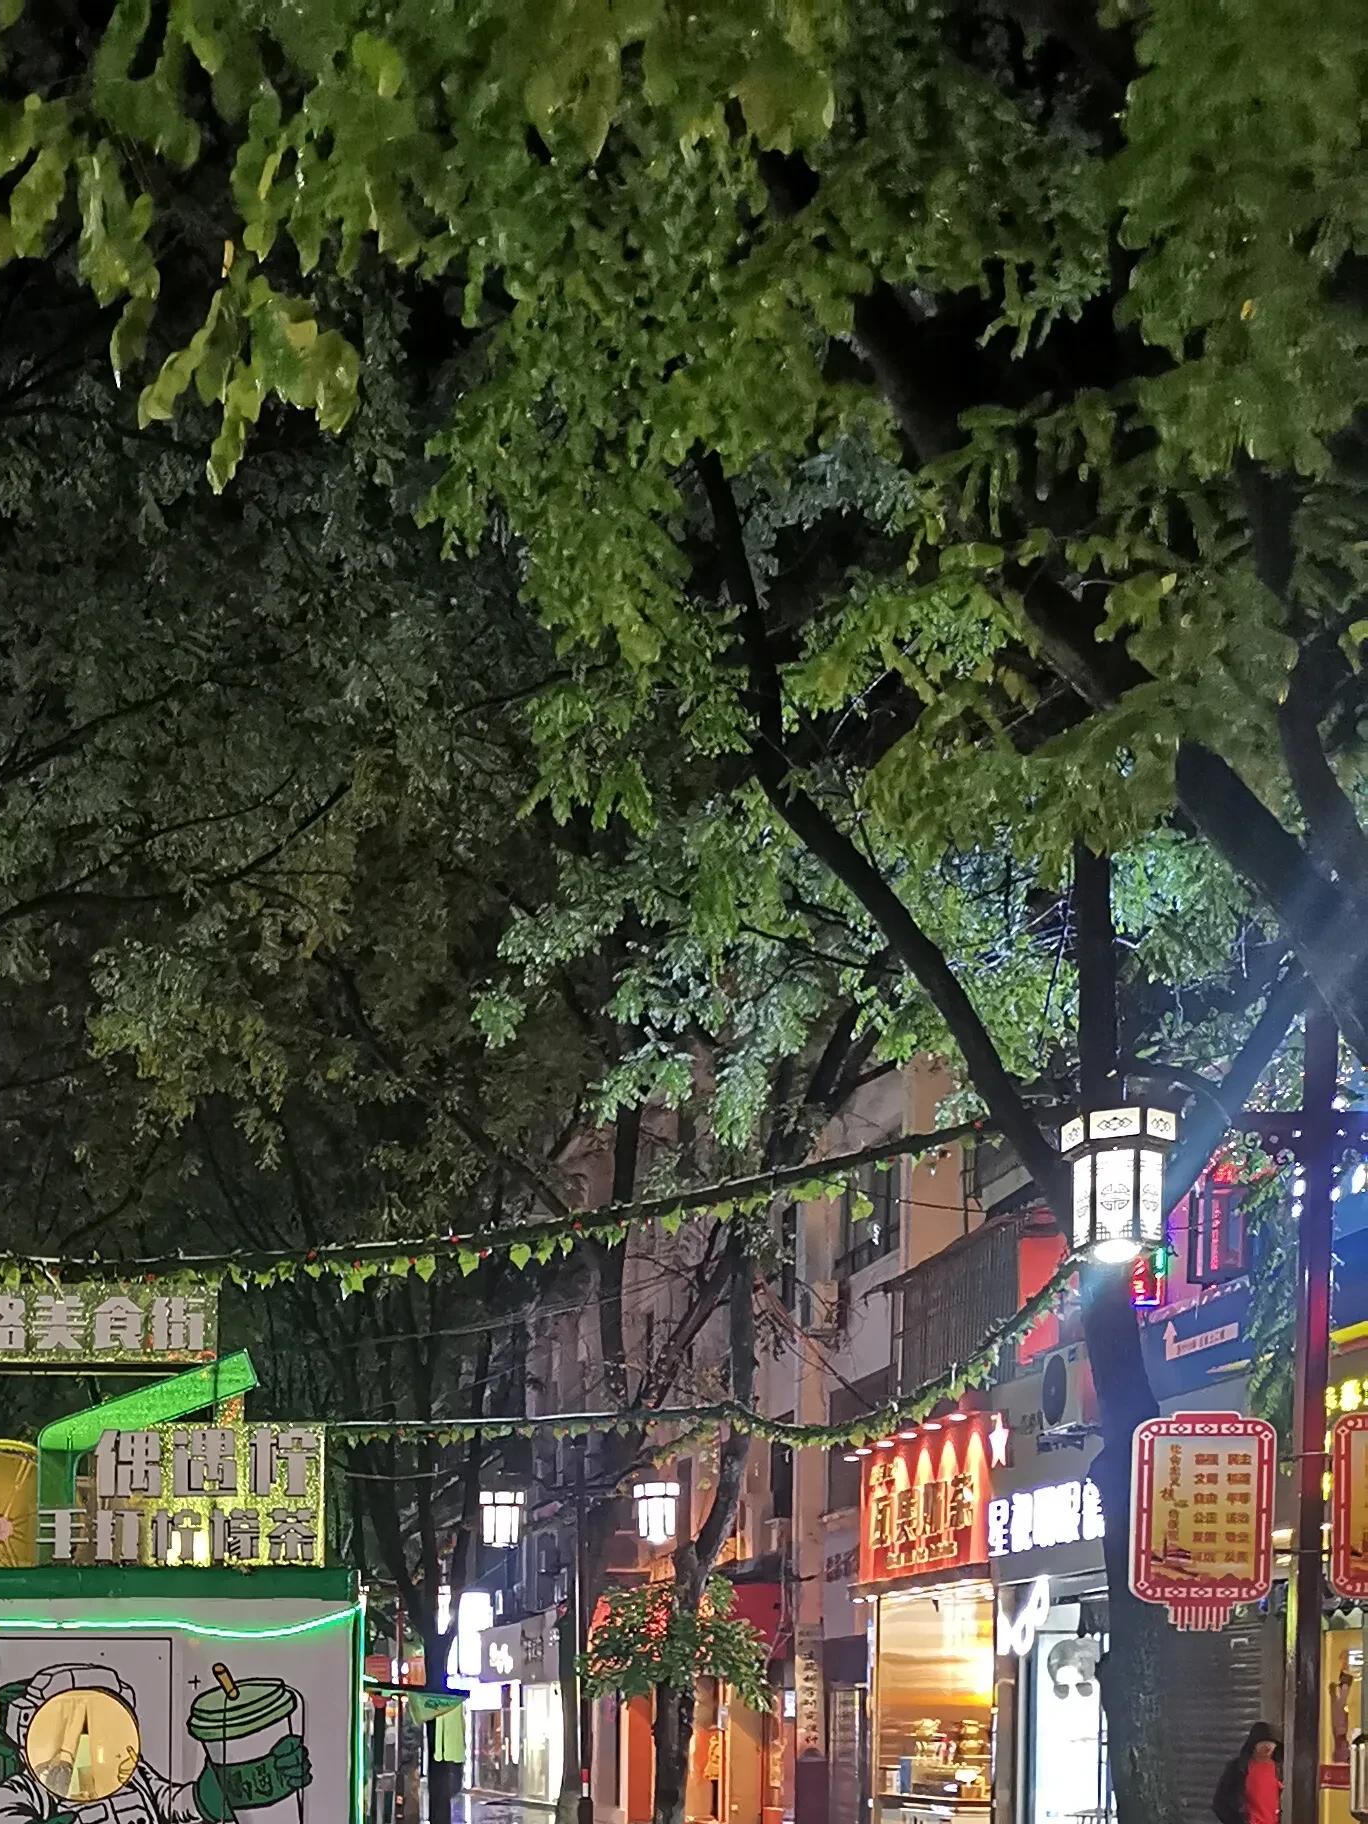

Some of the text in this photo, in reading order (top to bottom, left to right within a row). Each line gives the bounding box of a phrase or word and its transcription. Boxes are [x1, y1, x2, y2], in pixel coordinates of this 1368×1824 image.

[95, 1428, 317, 1499] 偶遇柠
[36, 1508, 318, 1563] 手打柠檬茶
